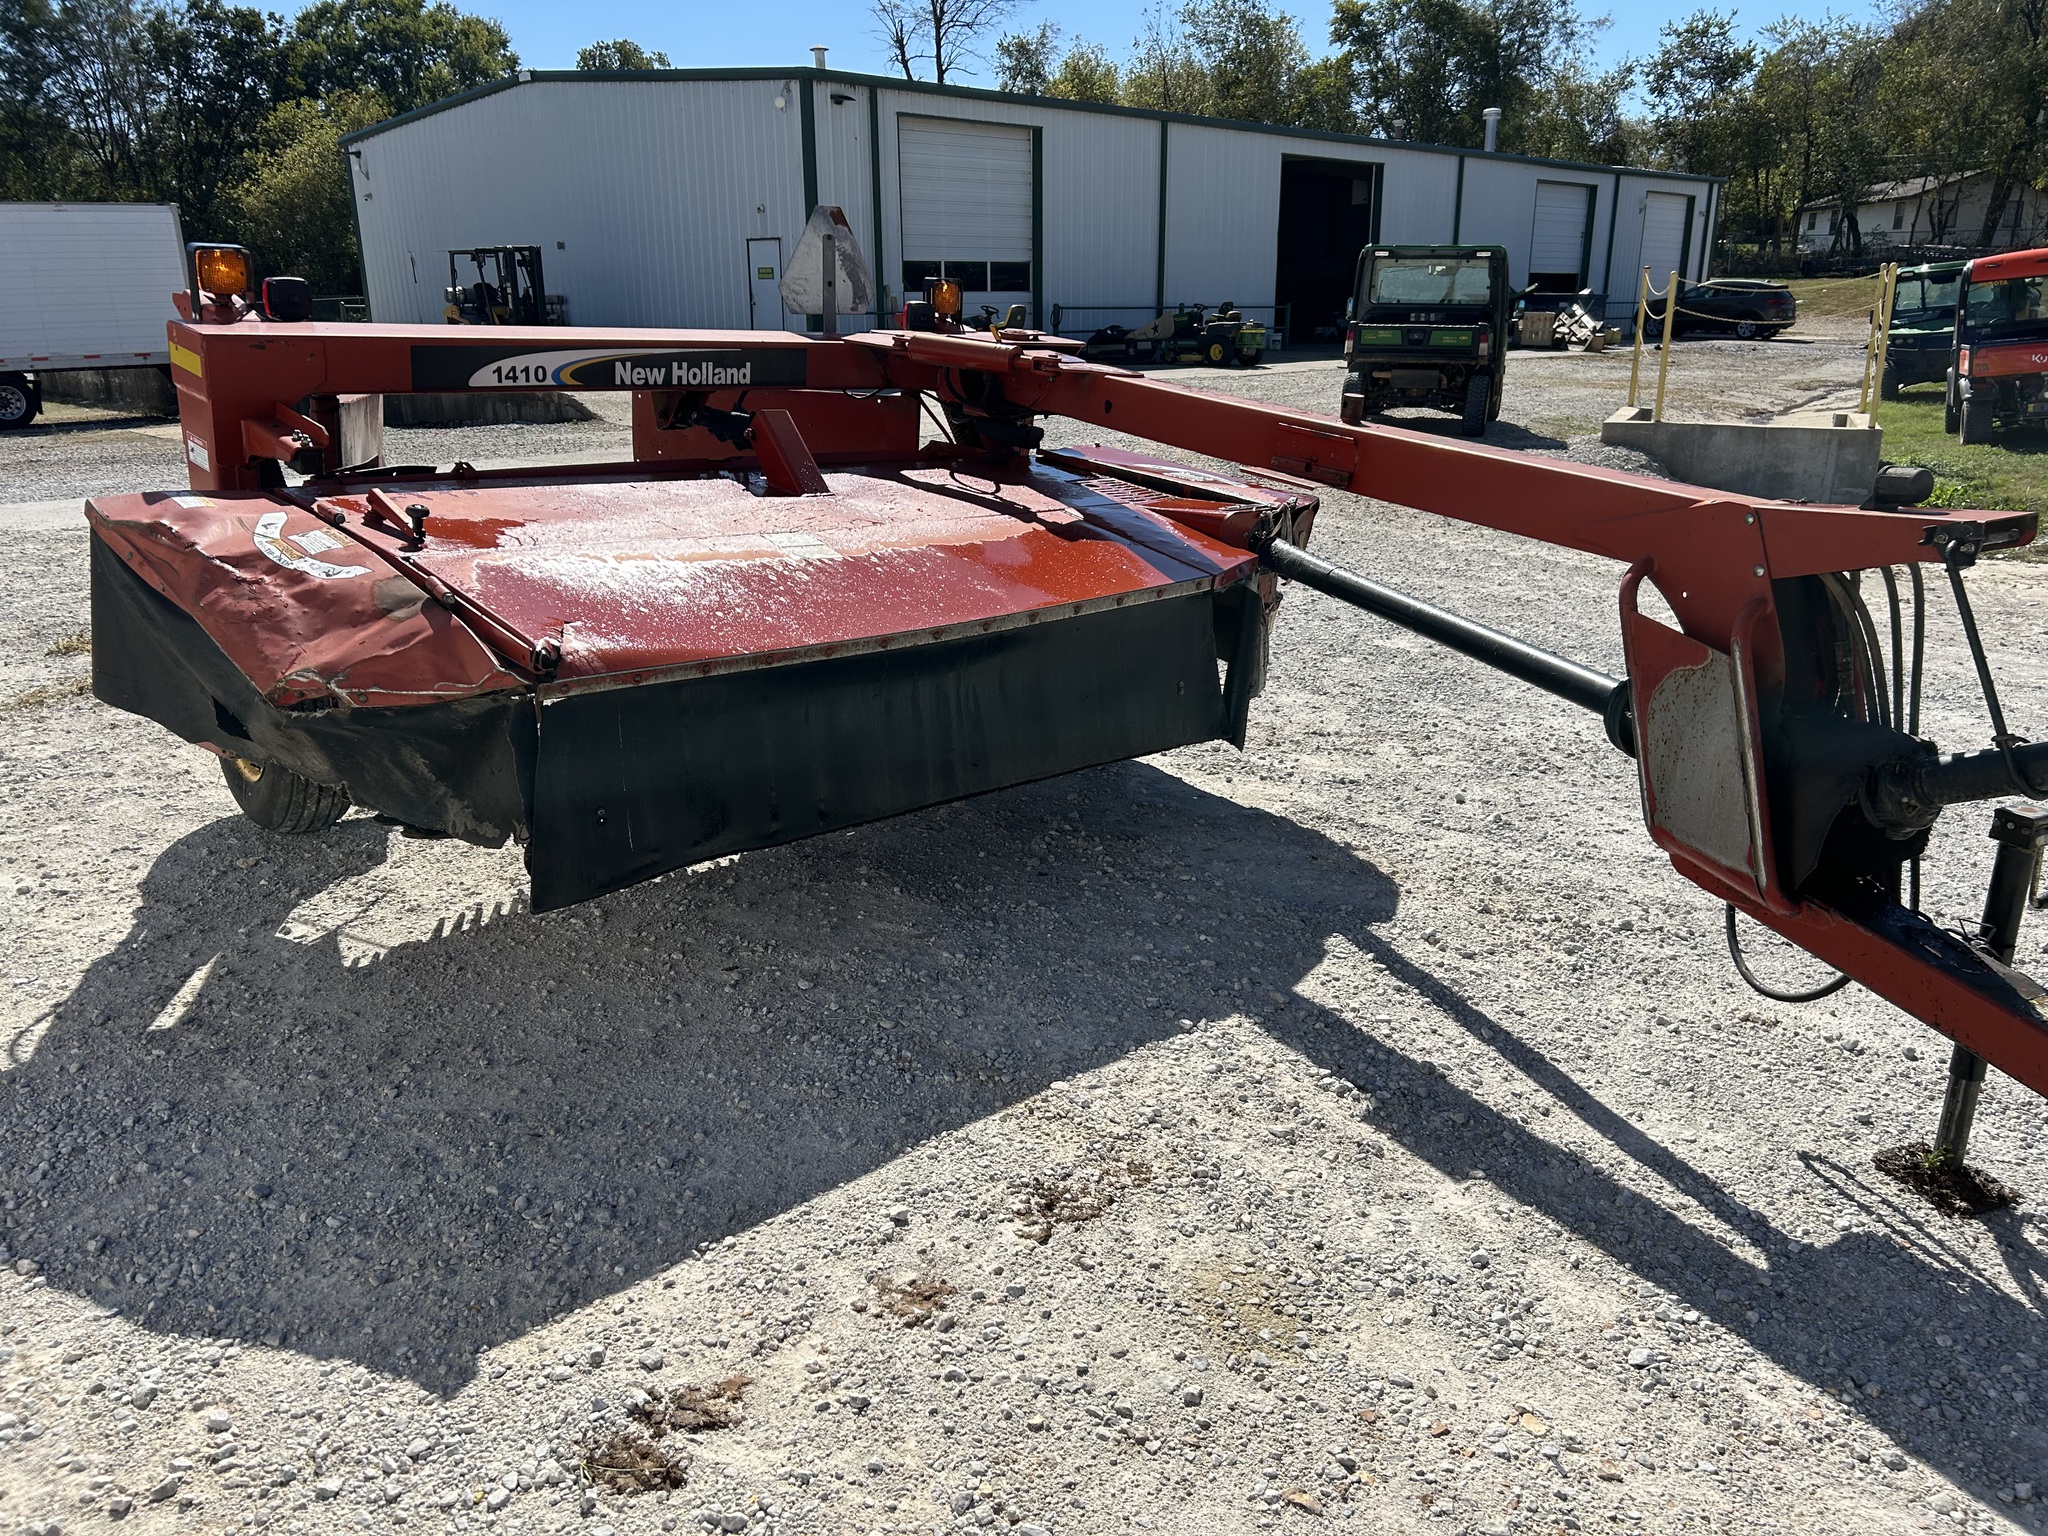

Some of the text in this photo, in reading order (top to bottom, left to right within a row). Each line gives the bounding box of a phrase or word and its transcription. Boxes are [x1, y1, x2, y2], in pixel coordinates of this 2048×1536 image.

[492, 365, 548, 384] 1410
[614, 361, 751, 386] New Holland
